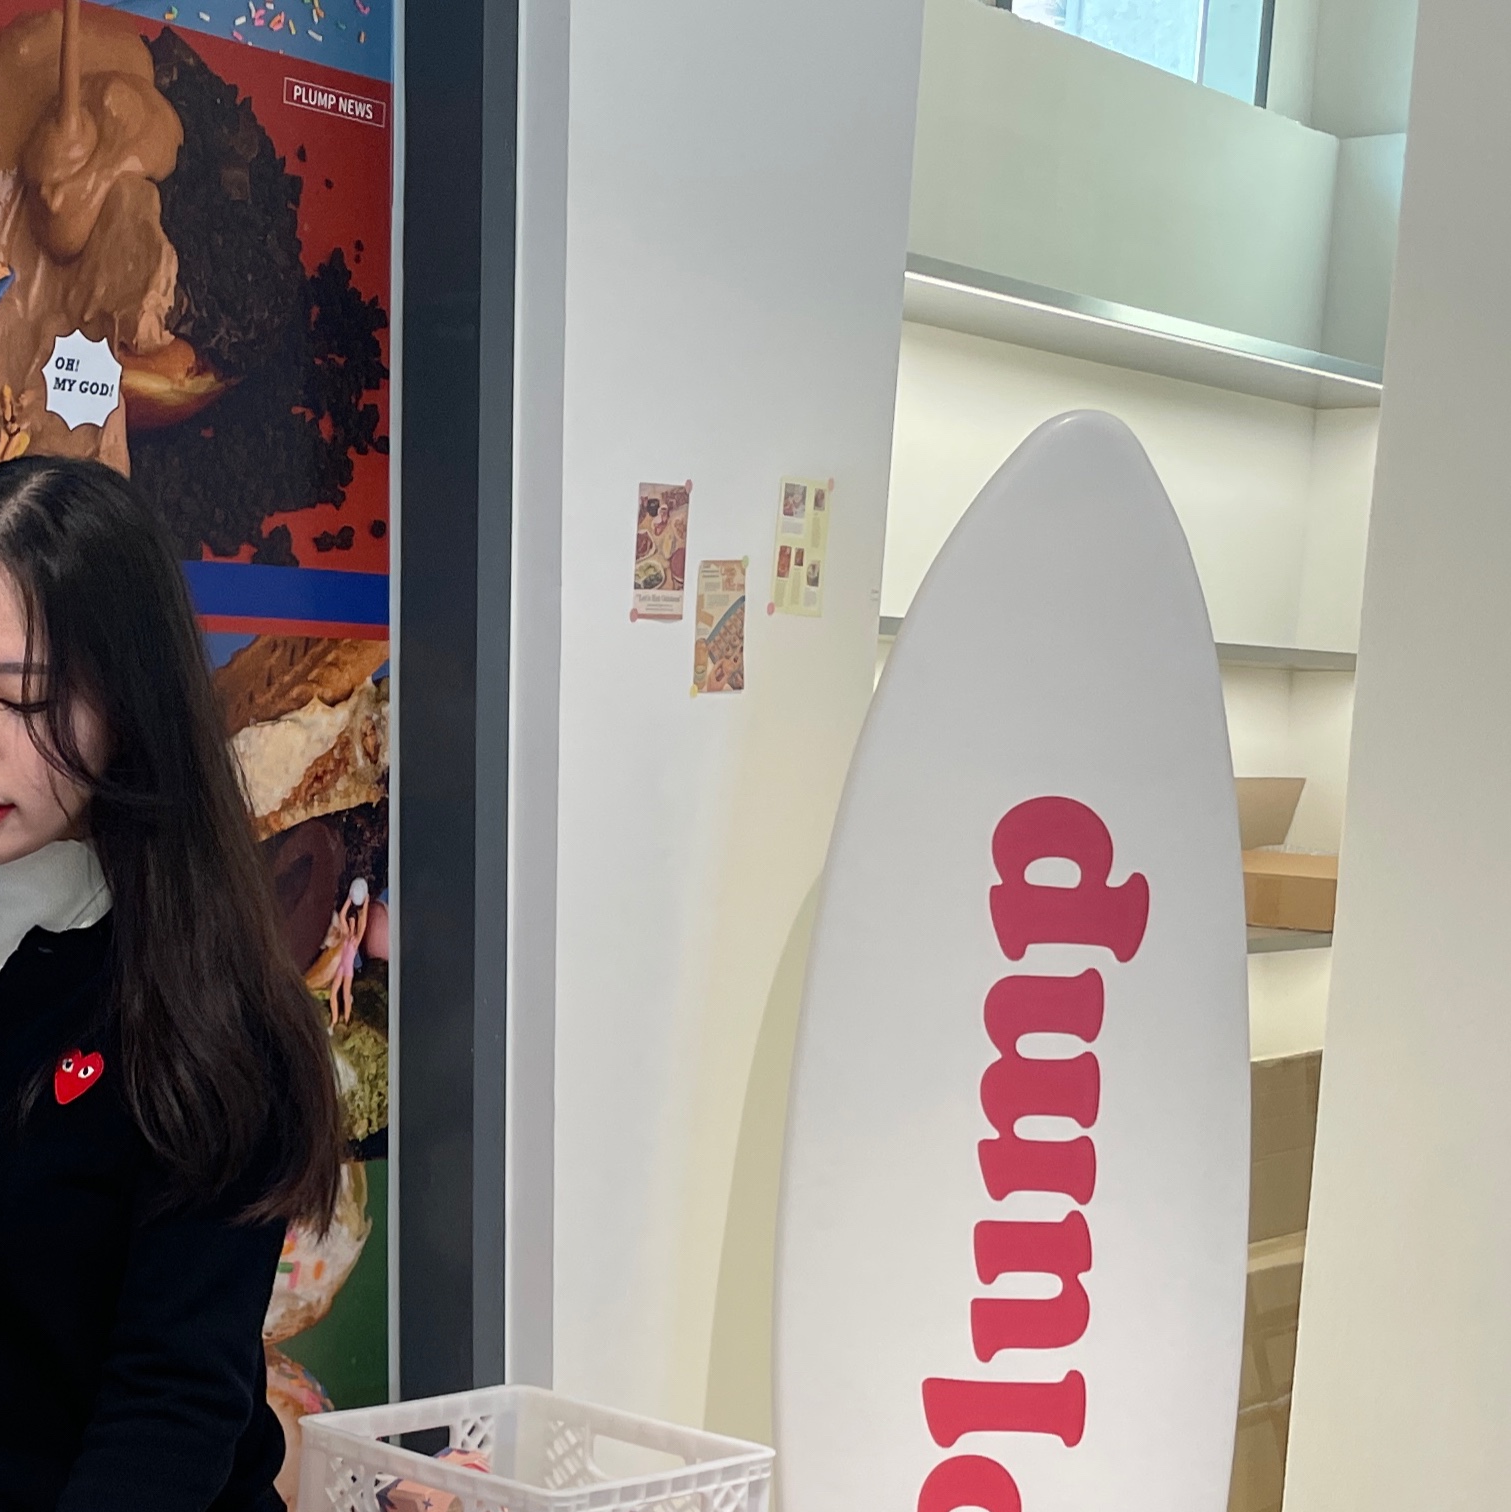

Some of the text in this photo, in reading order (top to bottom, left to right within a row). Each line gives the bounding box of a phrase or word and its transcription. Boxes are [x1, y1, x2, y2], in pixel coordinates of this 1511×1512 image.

[292, 84, 374, 120] PLUMP NEWS
[54, 356, 80, 372] OH!
[52, 376, 114, 397] MY GOD!
